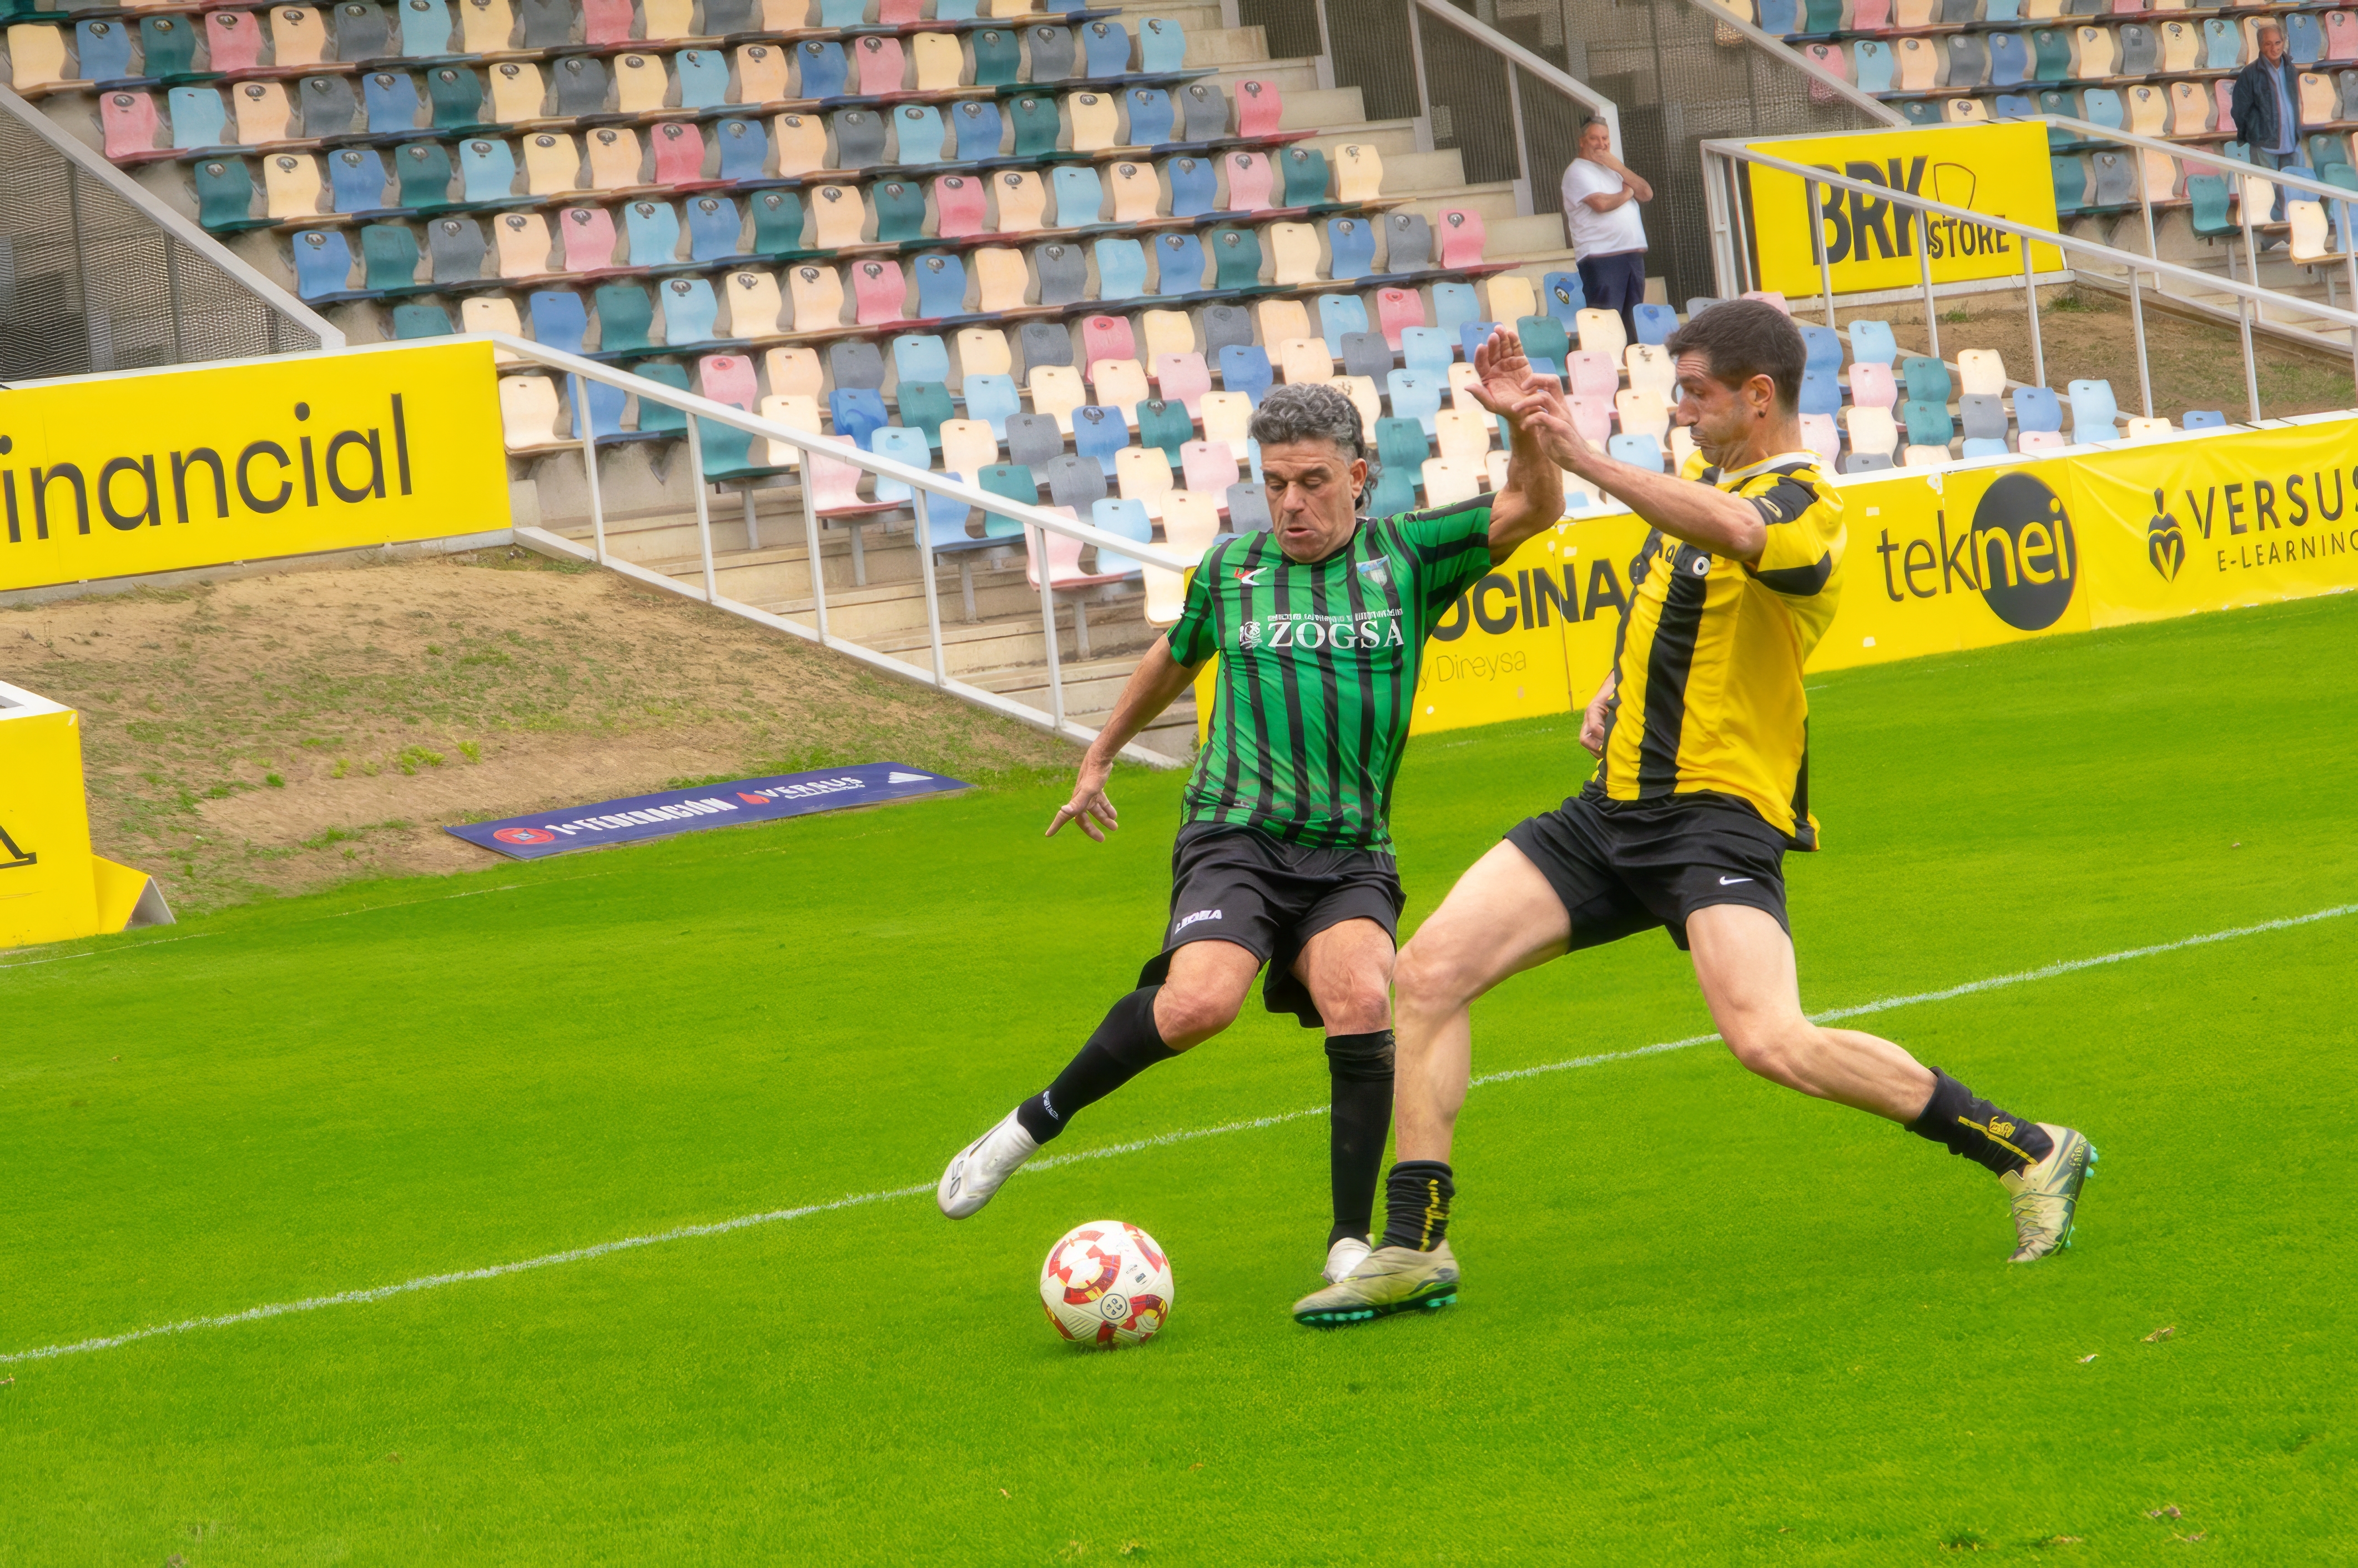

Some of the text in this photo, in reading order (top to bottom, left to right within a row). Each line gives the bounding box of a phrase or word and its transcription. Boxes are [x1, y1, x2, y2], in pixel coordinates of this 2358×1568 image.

[1803, 155, 1931, 266] BRK
[1930, 214, 2009, 260] STORE
[2185, 465, 2358, 540] VERSU
[1876, 497, 2071, 602] teknei
[1267, 618, 1404, 649] ZOGSA
